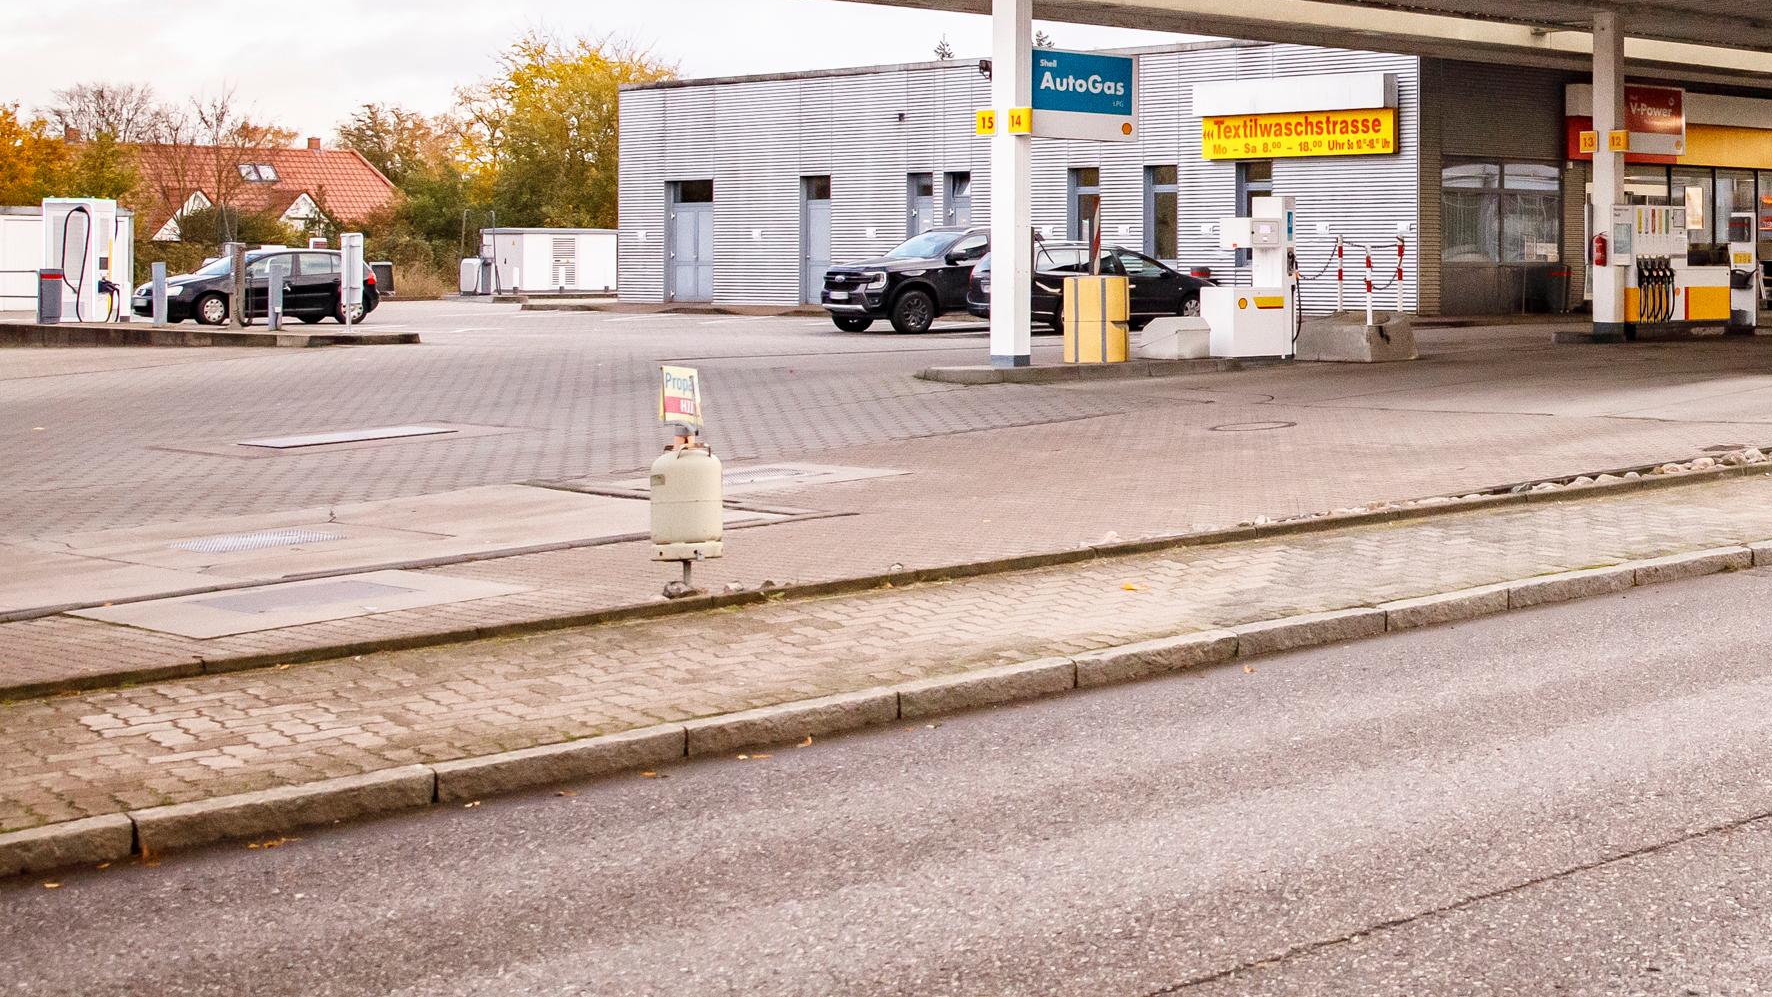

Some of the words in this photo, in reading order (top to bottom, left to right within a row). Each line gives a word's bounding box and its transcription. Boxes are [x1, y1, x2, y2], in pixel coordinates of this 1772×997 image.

[1039, 59, 1057, 68] Shell
[1040, 71, 1125, 96] AutoGas
[1629, 102, 1673, 117] V-Power
[981, 116, 994, 129] 15
[1010, 114, 1022, 127] 14
[1213, 115, 1382, 140] Textilwaschstrasse
[1213, 144, 1227, 155] Mo
[1244, 142, 1257, 154] Sa
[1327, 139, 1345, 151] Uhr
[1583, 136, 1594, 147] 13
[1610, 136, 1622, 146] 12
